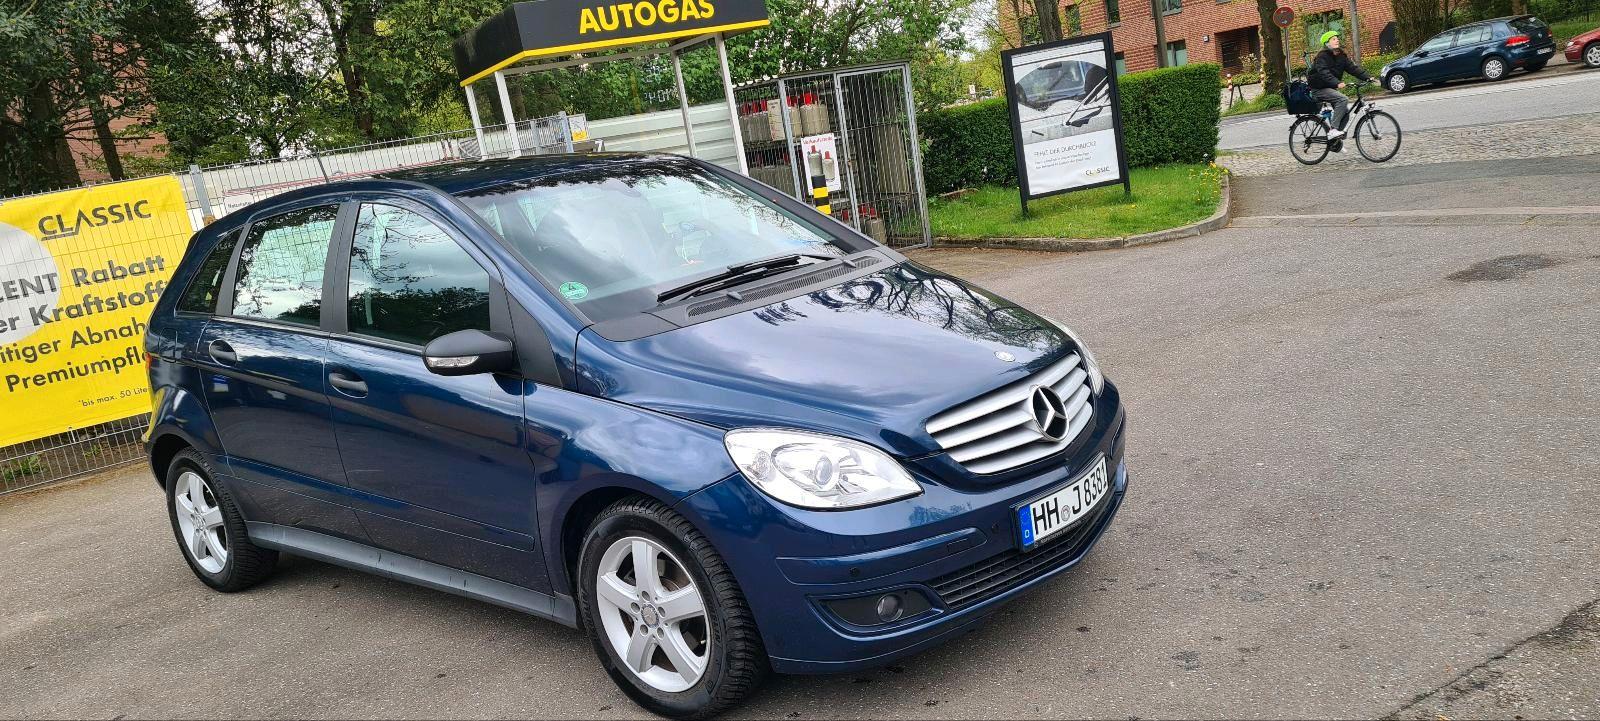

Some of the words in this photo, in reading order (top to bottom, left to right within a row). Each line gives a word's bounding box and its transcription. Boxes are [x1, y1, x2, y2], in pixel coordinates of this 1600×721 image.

[579, 0, 715, 34] AUTOGAS
[38, 199, 152, 241] CLASSIC
[0, 272, 58, 301] ENT
[70, 254, 165, 288] Rabatt
[5, 346, 146, 392] Premiumpfl
[119, 389, 132, 398] 50
[1032, 497, 1060, 535] HH
